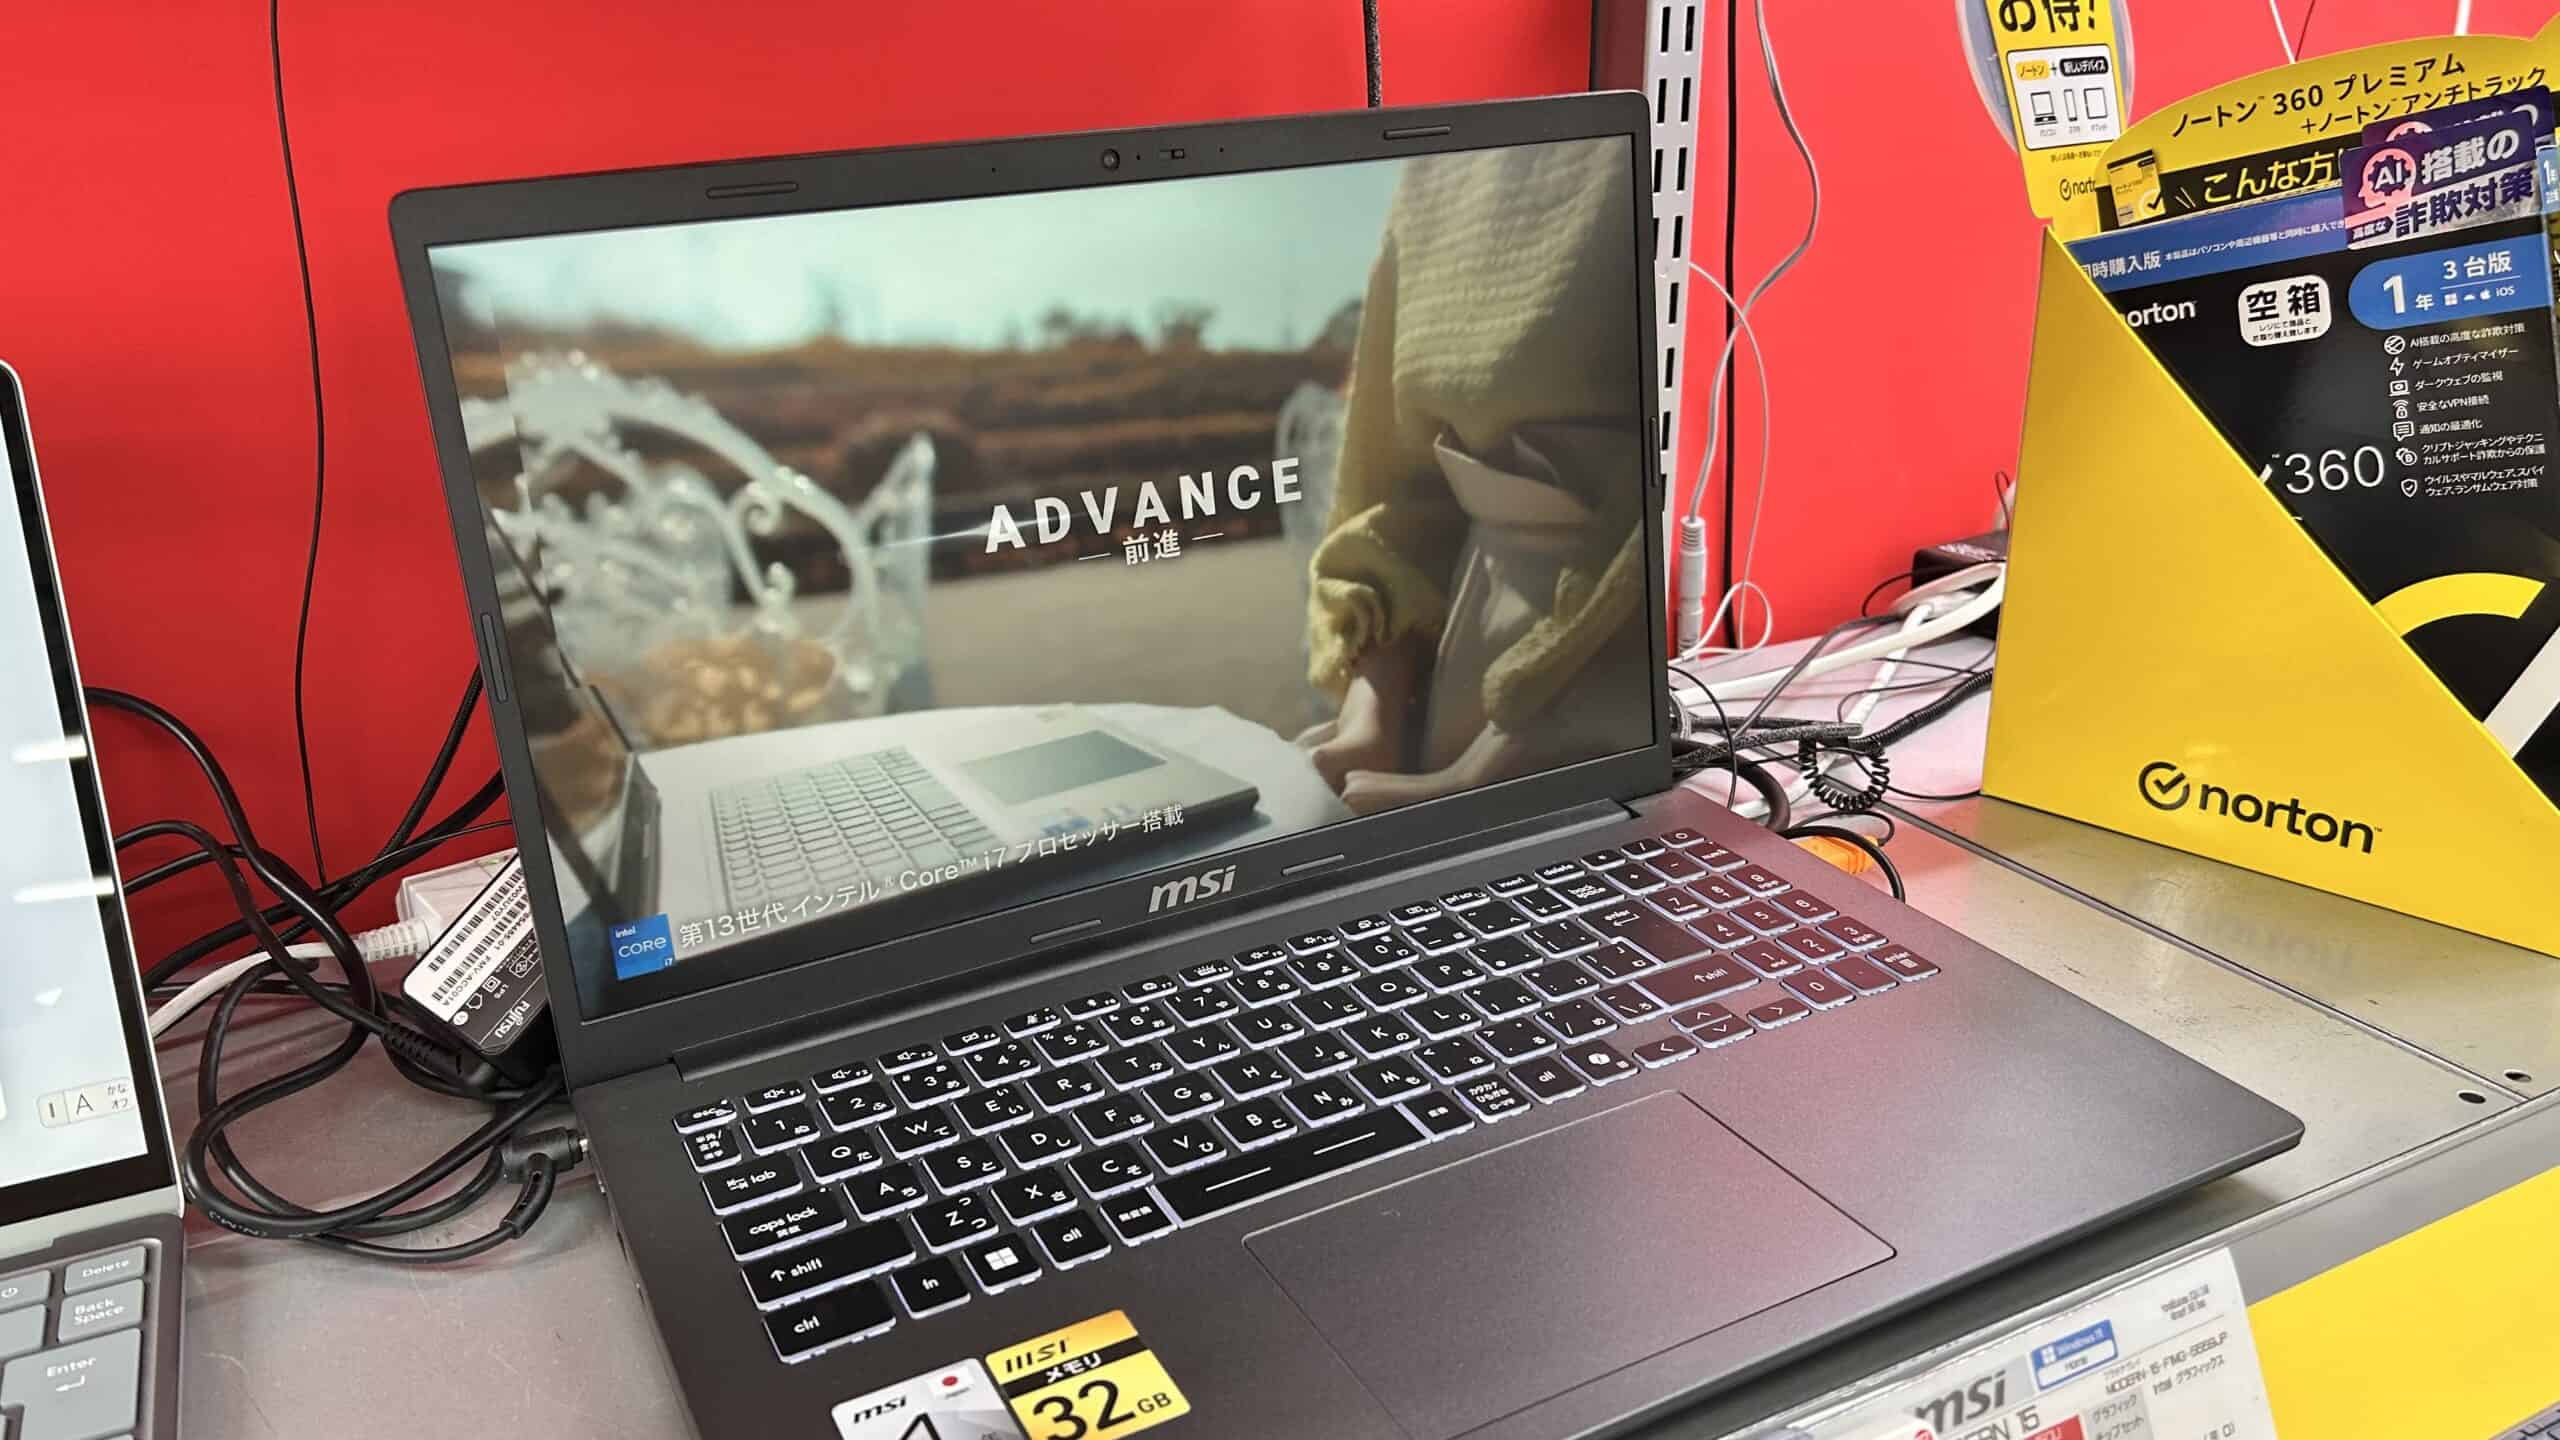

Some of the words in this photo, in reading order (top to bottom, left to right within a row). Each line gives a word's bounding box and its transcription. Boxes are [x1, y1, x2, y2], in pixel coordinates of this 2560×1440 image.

[2019, 65, 2046, 78] ノートン
[2272, 84, 2324, 115] 360
[2334, 53, 2465, 100] プレミアム
[2402, 66, 2546, 114] アンチトラック
[2374, 162, 2402, 191] AI
[2422, 129, 2520, 184] 搭載の
[2203, 148, 2344, 203] こんな方
[2071, 177, 2098, 196] nort
[2395, 167, 2534, 238] 詐欺対策
[2383, 274, 2406, 314] 1
[2416, 294, 2434, 311] 年
[2496, 285, 2515, 297] iOS
[2246, 282, 2321, 322] 空箱
[2120, 300, 2196, 329] orton
[2415, 371, 2504, 391] ダークウェブの監視
[2417, 395, 2490, 411] 安全なVPN接続
[2285, 445, 2385, 494] 360
[985, 457, 1302, 554] ADVANCE
[1122, 528, 1182, 565] 前進
[2199, 783, 2376, 854] norton
[1148, 865, 1237, 913] msi
[679, 902, 788, 948] 第13世代
[984, 848, 1006, 871] i7
[1754, 911, 1769, 920] 5
[1844, 927, 1859, 936] 3
[1802, 938, 1818, 948] 2
[1439, 965, 1451, 975] P
[1257, 979, 1270, 989] 8
[1193, 996, 1204, 1007] 7
[1130, 1016, 1144, 1026] 6
[1433, 1009, 1450, 1019] L
[1257, 1018, 1273, 1030] U
[1371, 1026, 1389, 1039] K
[1063, 1035, 1078, 1045] 5
[1192, 1037, 1206, 1048] Y
[1314, 1046, 1324, 1058] J
[1125, 1057, 1140, 1068] T
[1242, 1065, 1261, 1079] H
[1380, 1070, 1401, 1084] M
[1538, 1070, 1557, 1083] alt
[924, 1076, 937, 1086] 3
[1056, 1078, 1073, 1090] R
[1174, 1087, 1192, 1099] G
[1313, 1090, 1333, 1105] N
[75, 1092, 94, 1116] A
[851, 1098, 866, 1109] 2
[985, 1100, 1001, 1112] E
[1104, 1109, 1118, 1122] F
[1246, 1113, 1263, 1127] B
[904, 1120, 928, 1135] W
[1030, 1133, 1047, 1145] D
[1173, 1135, 1190, 1149] V
[831, 1146, 851, 1158] Q
[957, 1156, 971, 1168] S
[1102, 1159, 1120, 1173] C
[879, 1182, 895, 1195] A
[1024, 1184, 1044, 1199] X
[749, 1218, 786, 1235] caps
[786, 1206, 818, 1223] lock
[945, 1211, 965, 1227] Z
[1062, 1227, 1083, 1243] alt
[82, 1260, 130, 1278] Delete
[790, 1257, 823, 1277] shift
[922, 1278, 939, 1290] fn
[74, 1299, 114, 1315] Back
[74, 1305, 126, 1325] Space
[793, 1315, 820, 1333] ctrl
[46, 1357, 97, 1378] Enter
[1047, 1352, 1102, 1383] メモリ
[1915, 1369, 2006, 1433] msi
[1032, 1379, 1137, 1440] 32
[1137, 1391, 1173, 1415] GB
